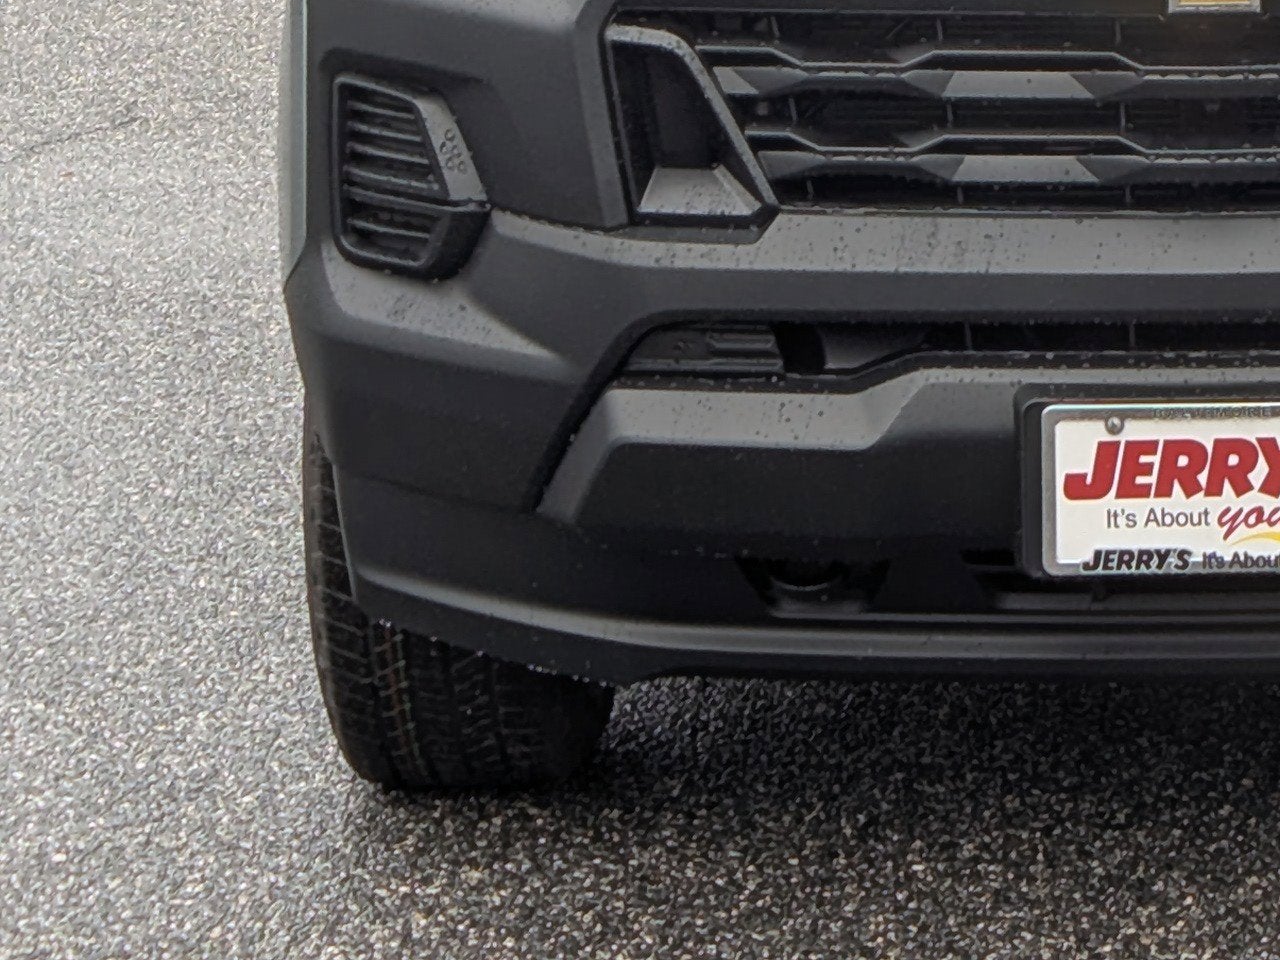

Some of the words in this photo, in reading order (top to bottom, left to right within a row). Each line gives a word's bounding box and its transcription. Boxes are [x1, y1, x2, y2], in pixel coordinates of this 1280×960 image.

[1106, 508, 1138, 529] It's
[1144, 507, 1211, 528] About
[1081, 548, 1193, 571] JERRY'S
[1202, 551, 1226, 569] It's
